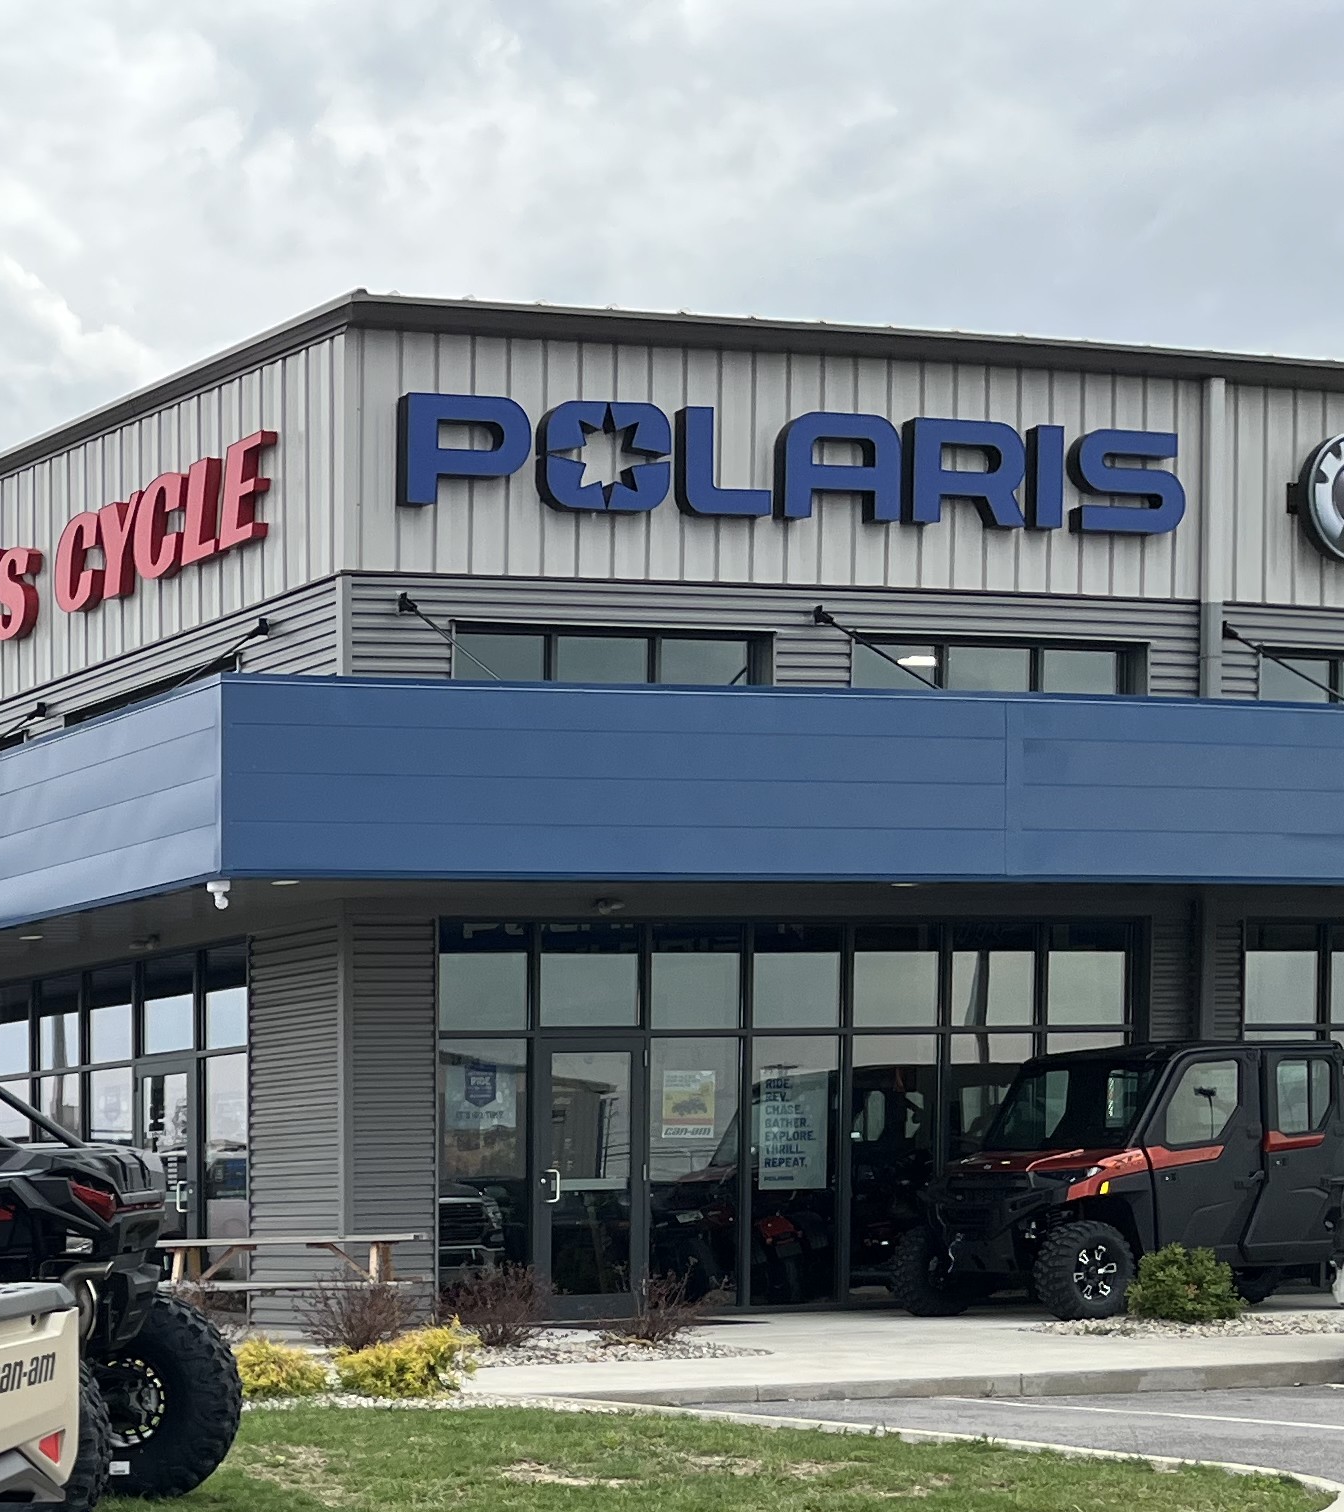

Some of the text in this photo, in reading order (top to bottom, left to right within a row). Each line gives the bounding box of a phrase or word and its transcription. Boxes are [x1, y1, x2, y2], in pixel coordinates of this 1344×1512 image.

[396, 391, 1186, 535] POLARIS
[54, 429, 278, 613] CYCLE
[765, 1104, 804, 1115] CHASE.
[764, 1117, 810, 1129] GATHER.
[764, 1130, 816, 1141] EXPLORE.
